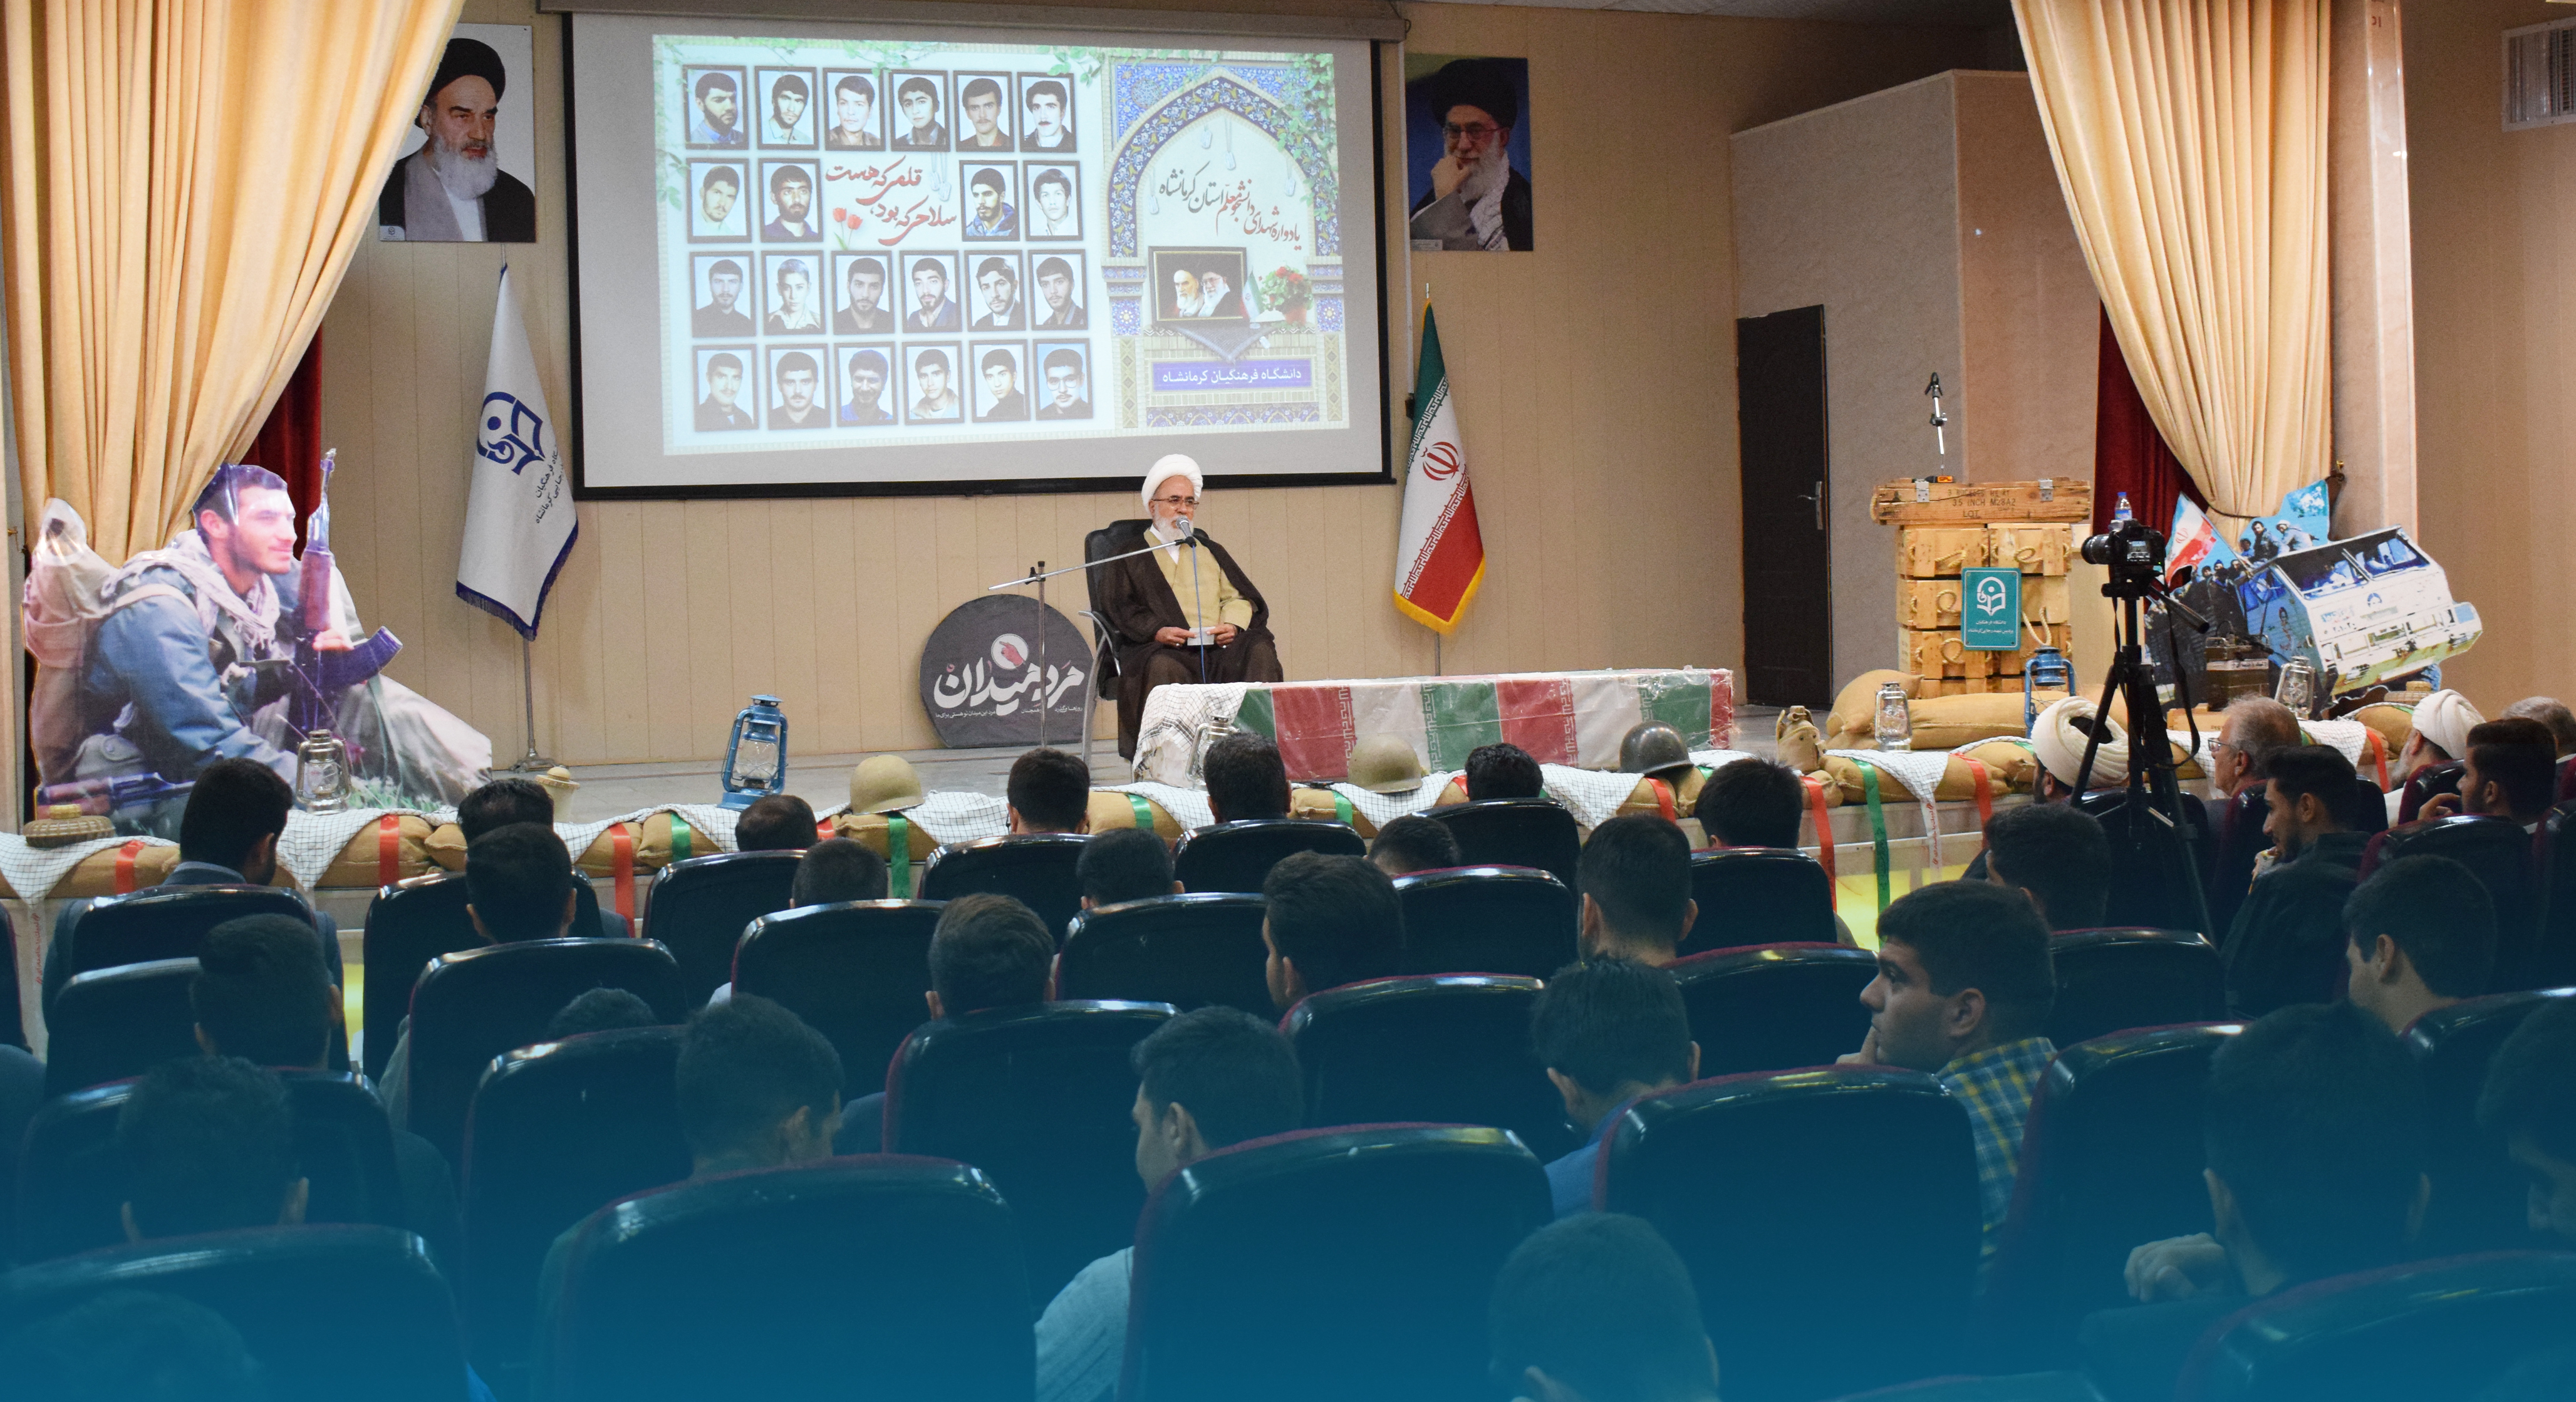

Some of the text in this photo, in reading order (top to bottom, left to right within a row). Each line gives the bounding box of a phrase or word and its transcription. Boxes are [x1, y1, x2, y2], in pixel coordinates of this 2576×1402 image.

[825, 165, 880, 181] هست
[871, 155, 906, 188] که
[1159, 160, 1210, 201] کرمانشاه
[894, 195, 929, 229] که
[1188, 182, 1223, 213] استان
[1162, 368, 1302, 385] دانشگاه فرهنگیان کرمانشاه
[536, 492, 553, 524] کرمانشاه
[1963, 509, 1980, 518] LOT
[1968, 498, 1985, 506] INCH
[934, 657, 1041, 716] میدان
